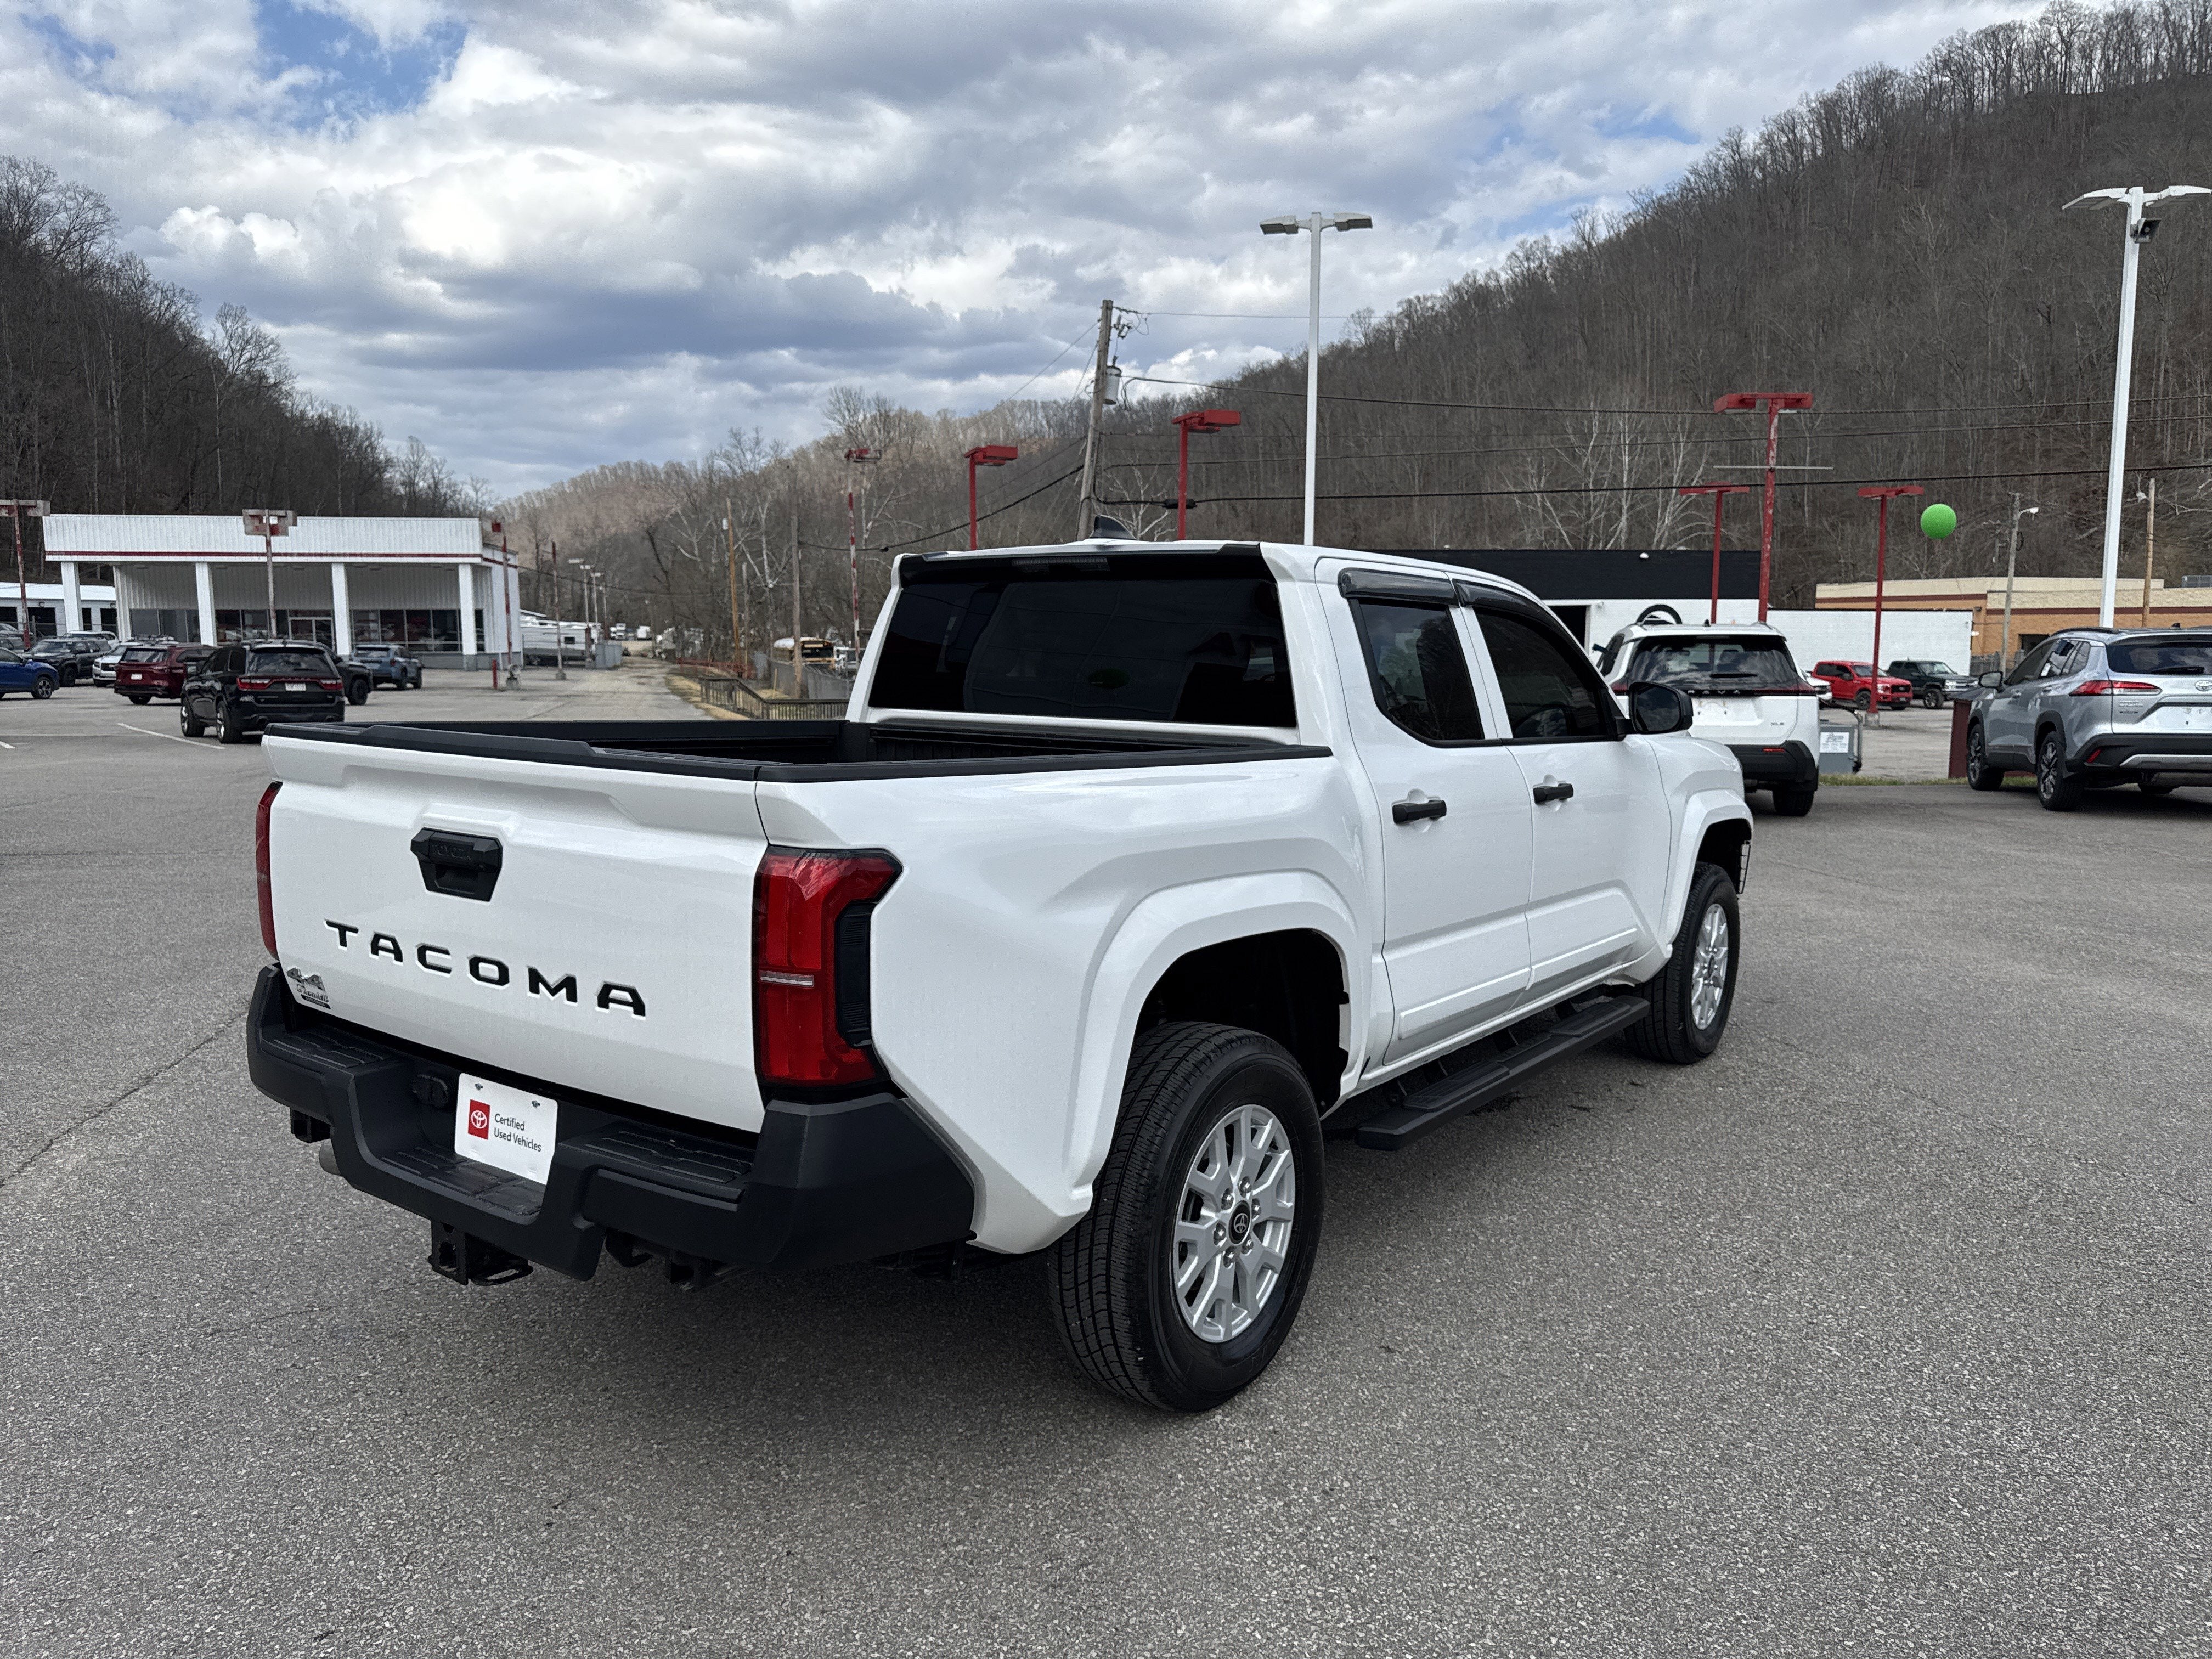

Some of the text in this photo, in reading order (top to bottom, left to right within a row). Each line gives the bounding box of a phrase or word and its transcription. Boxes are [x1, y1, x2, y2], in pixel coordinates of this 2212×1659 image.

[325, 918, 646, 1017] TACOMA
[495, 1113, 525, 1131] Certified
[494, 1127, 541, 1152] Used Vehicles
